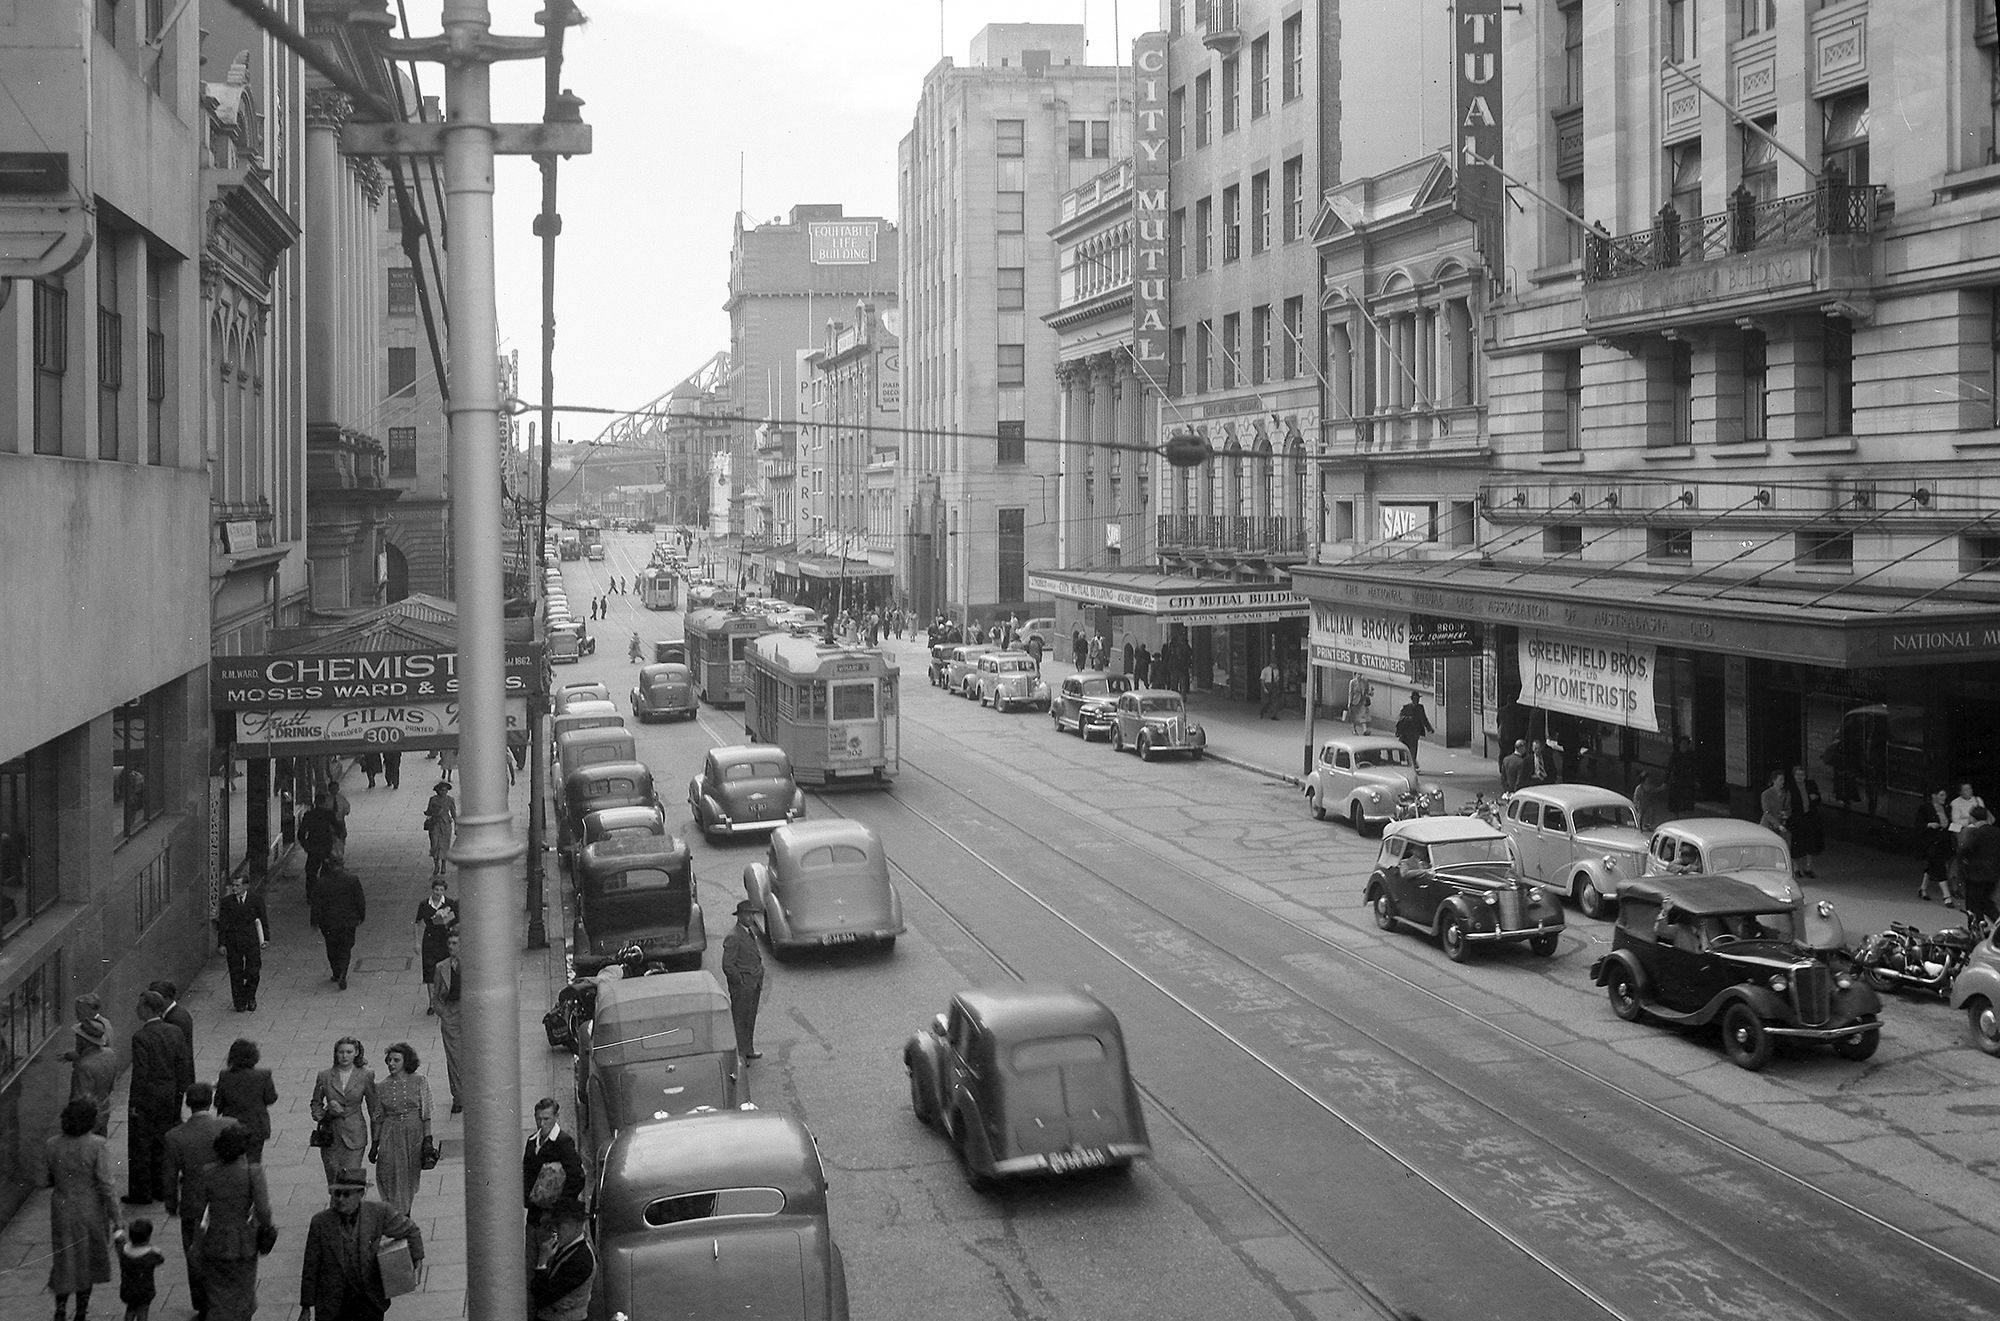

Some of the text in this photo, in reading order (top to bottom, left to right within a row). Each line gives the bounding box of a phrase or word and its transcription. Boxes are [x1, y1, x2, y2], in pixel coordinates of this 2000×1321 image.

[1138, 50, 1165, 161] CITY
[819, 248, 868, 259] BUILDING
[832, 237, 858, 248] LIFE
[1137, 189, 1167, 361] MUTUAL
[801, 381, 810, 521] PLAYERS
[1383, 507, 1417, 540] SAVE
[1169, 597, 1197, 609] CITY
[1200, 594, 1245, 607] MUTUAL
[1316, 612, 1405, 645] WILLIAM BROOKS
[1487, 600, 1550, 617] ASSOCIATION
[1565, 608, 1577, 621] OF
[1594, 612, 1671, 633] AUSTRALASIA
[1689, 622, 1713, 639] LTD
[1893, 630, 1975, 650] NATIONAL
[265, 653, 459, 684] CHEMIST
[1316, 647, 1406, 674] PRINTERS & STATIONERS
[1528, 639, 1649, 679] GREENFIELD BROS.
[1569, 667, 1598, 681] PTY LTD
[228, 676, 526, 702] MOSES WARD & SS.
[1535, 673, 1637, 711] OPTOMETRISTS
[342, 707, 425, 728] FILMS
[405, 726, 434, 734] PRINTED
[275, 726, 322, 739] DRINKS
[331, 726, 364, 738] DEVELOPED
[366, 728, 400, 744] 300
